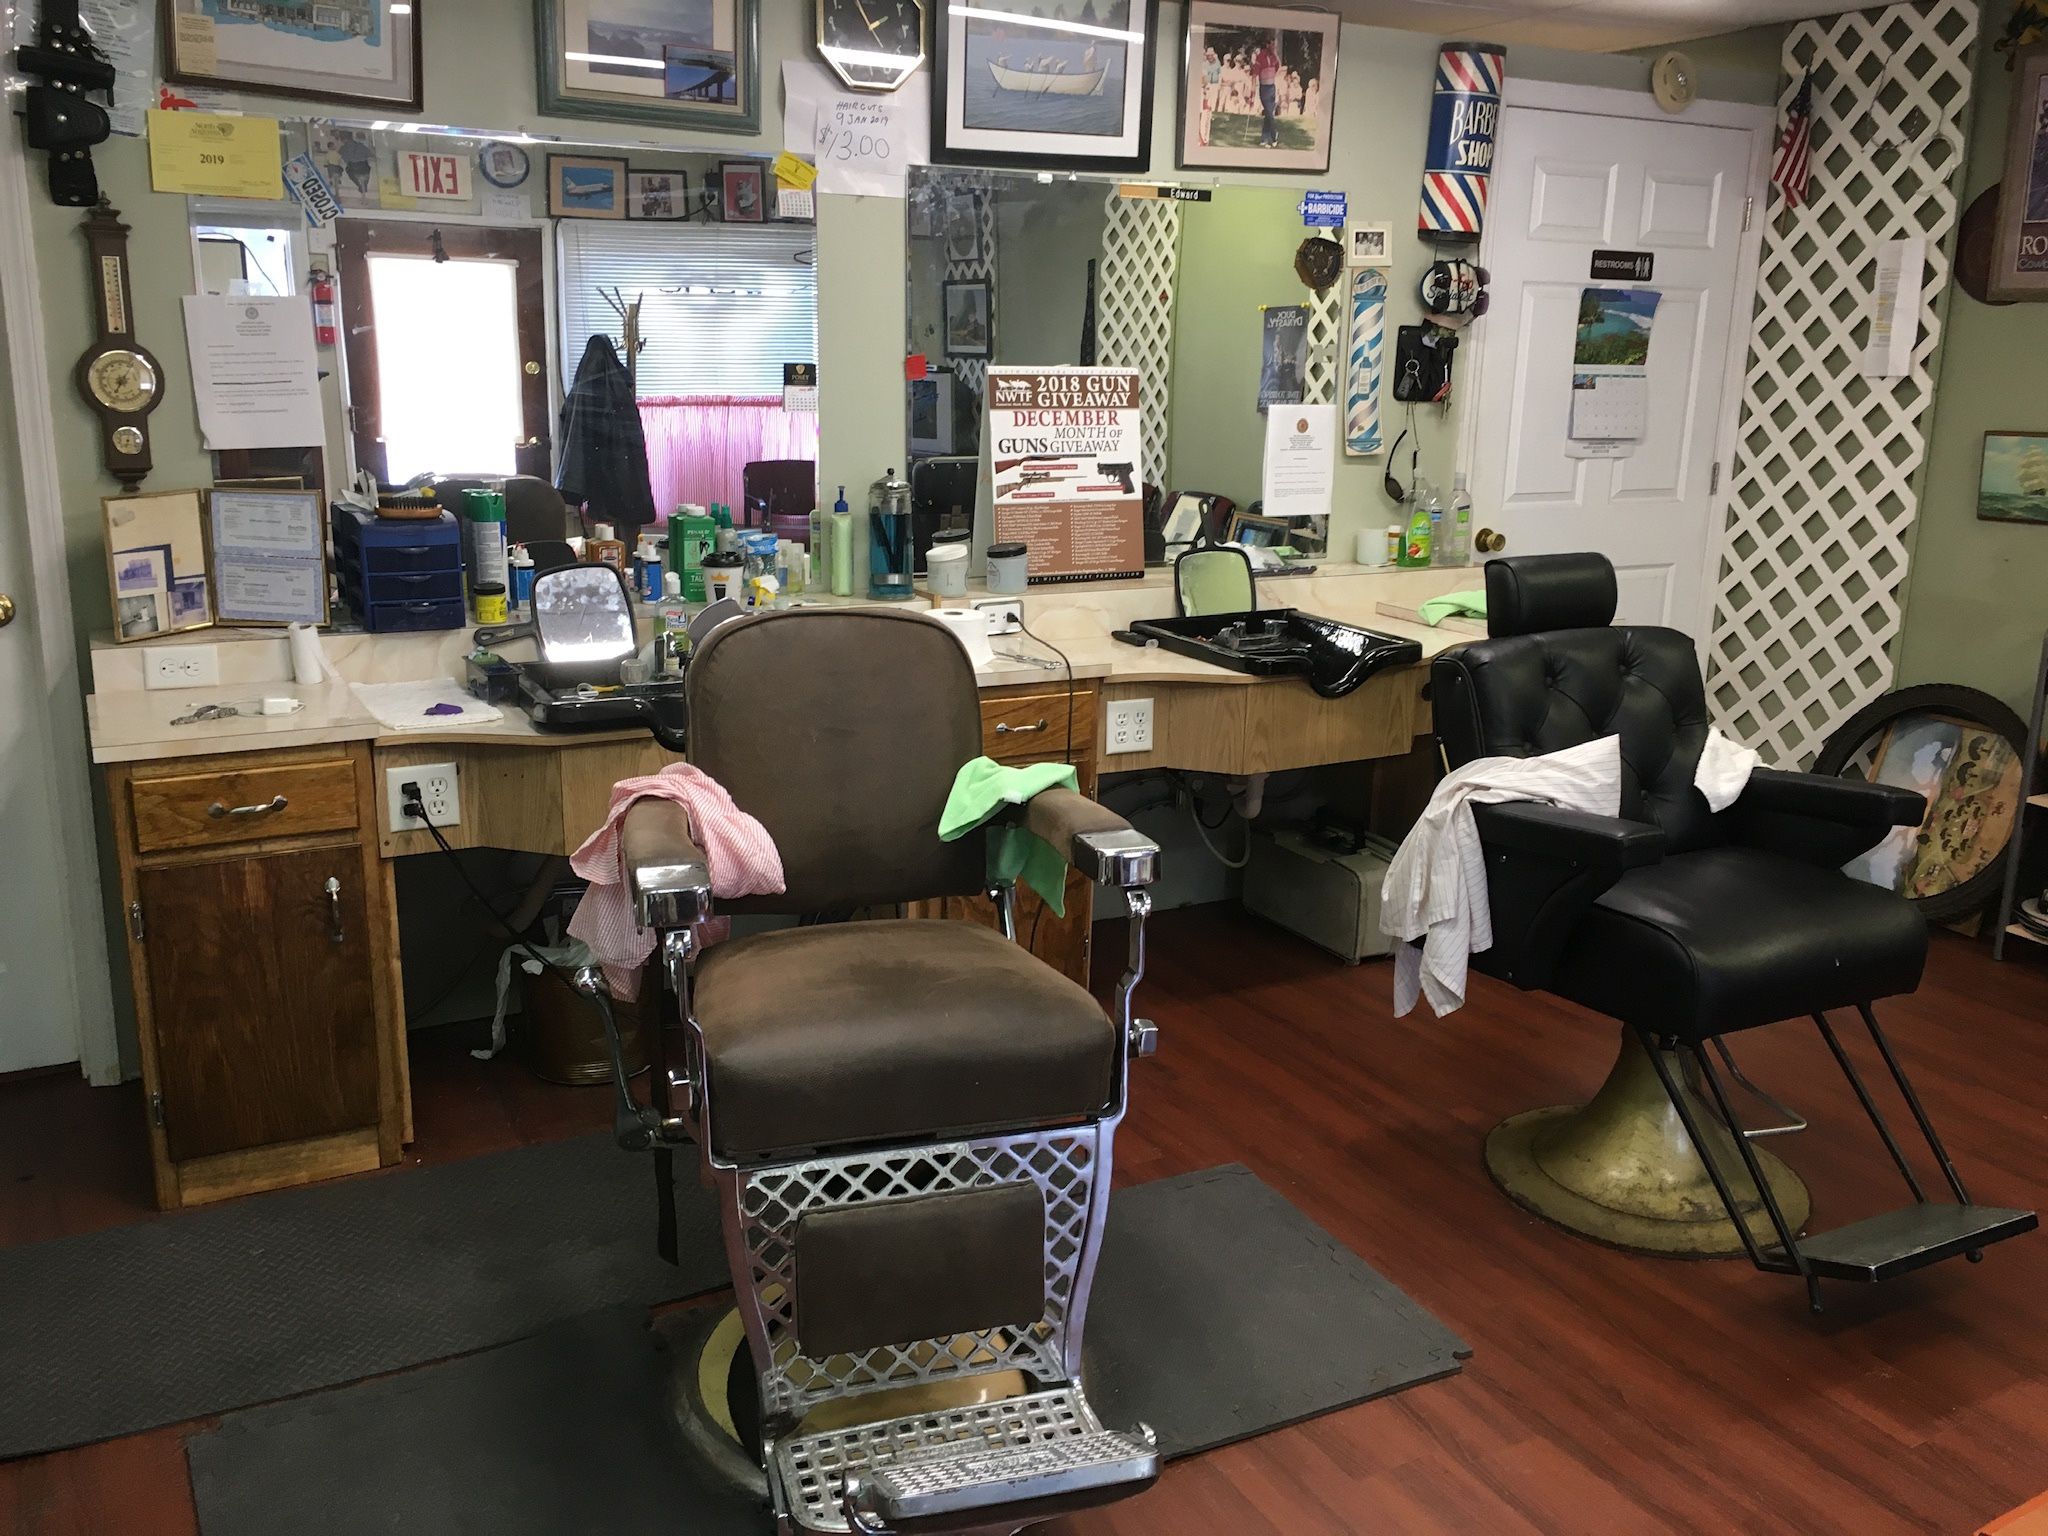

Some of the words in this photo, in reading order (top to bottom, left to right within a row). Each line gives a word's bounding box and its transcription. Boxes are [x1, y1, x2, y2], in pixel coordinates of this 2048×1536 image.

[836, 113, 844, 125] 9
[848, 113, 868, 125] JAN
[870, 115, 889, 126] 2019
[200, 153, 224, 165] 2019
[1455, 139, 1493, 168] SHOP
[1170, 188, 1199, 200] Edward
[1307, 203, 1345, 215] BARBICIDE
[1594, 260, 1634, 270] RESTROOMS
[1037, 376, 1080, 392] 2018
[1086, 376, 1131, 393] GUN
[996, 391, 1032, 402] NWTF
[1037, 392, 1131, 408] GIVEAWAY
[1013, 410, 1120, 427] DECEMBER
[1054, 426, 1107, 439] MONTH
[1109, 429, 1123, 438] OF
[998, 438, 1048, 454] GUNS
[1050, 439, 1120, 453] GIVEAWAY
